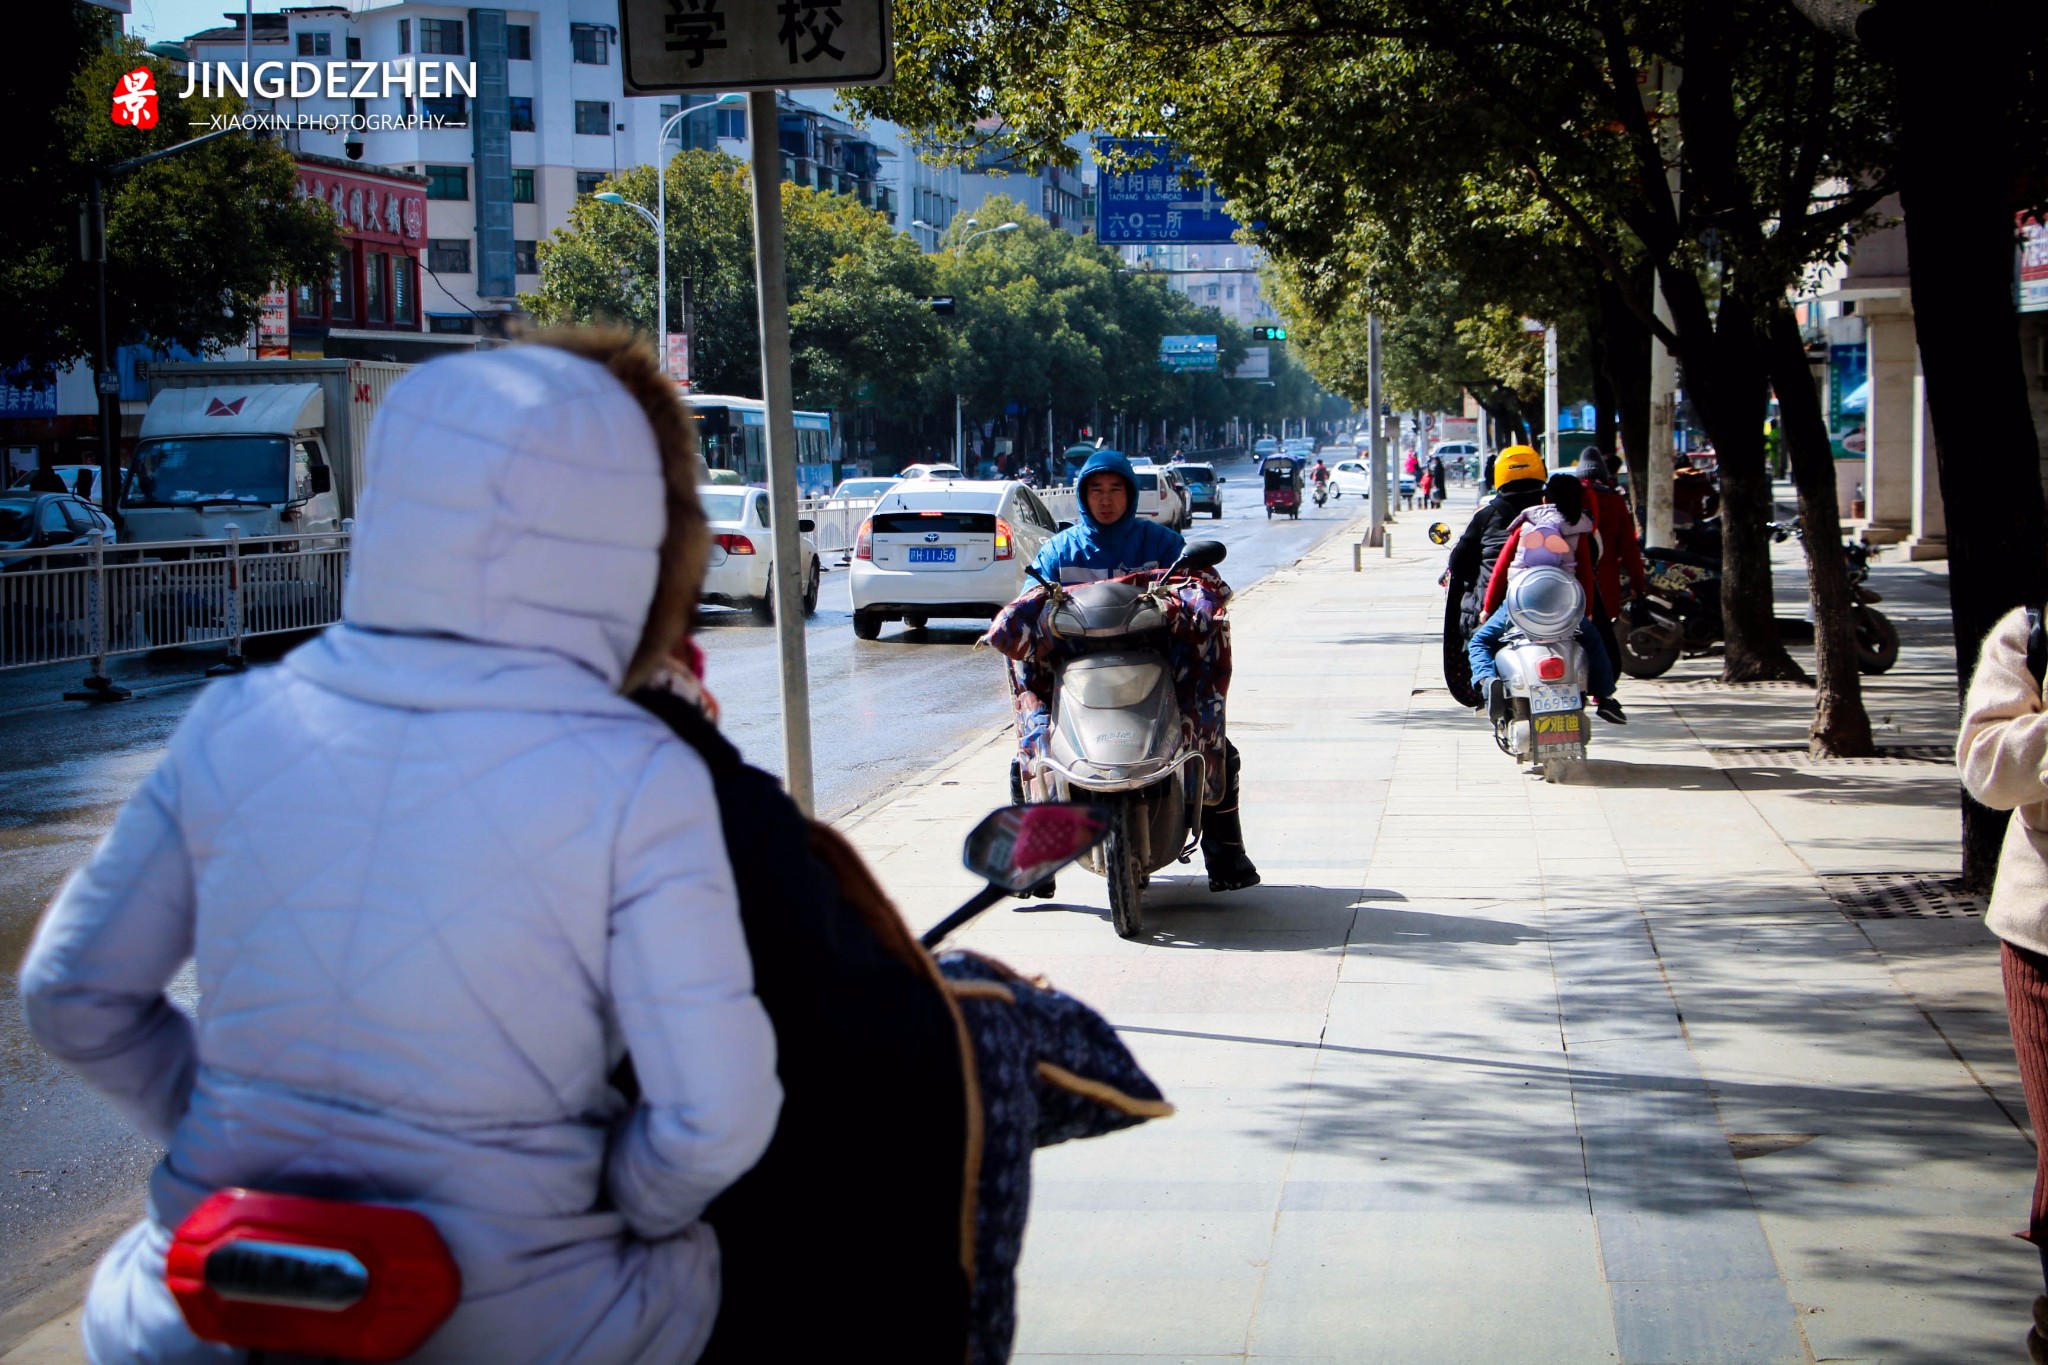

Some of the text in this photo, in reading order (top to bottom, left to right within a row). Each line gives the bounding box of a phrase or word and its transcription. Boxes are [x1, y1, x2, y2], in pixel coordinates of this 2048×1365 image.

[665, 0, 846, 69] 学校
[1108, 174, 1182, 193] 陶阳南路
[1108, 193, 1139, 201] TAOYANG
[1550, 714, 1580, 732] 雅迪
